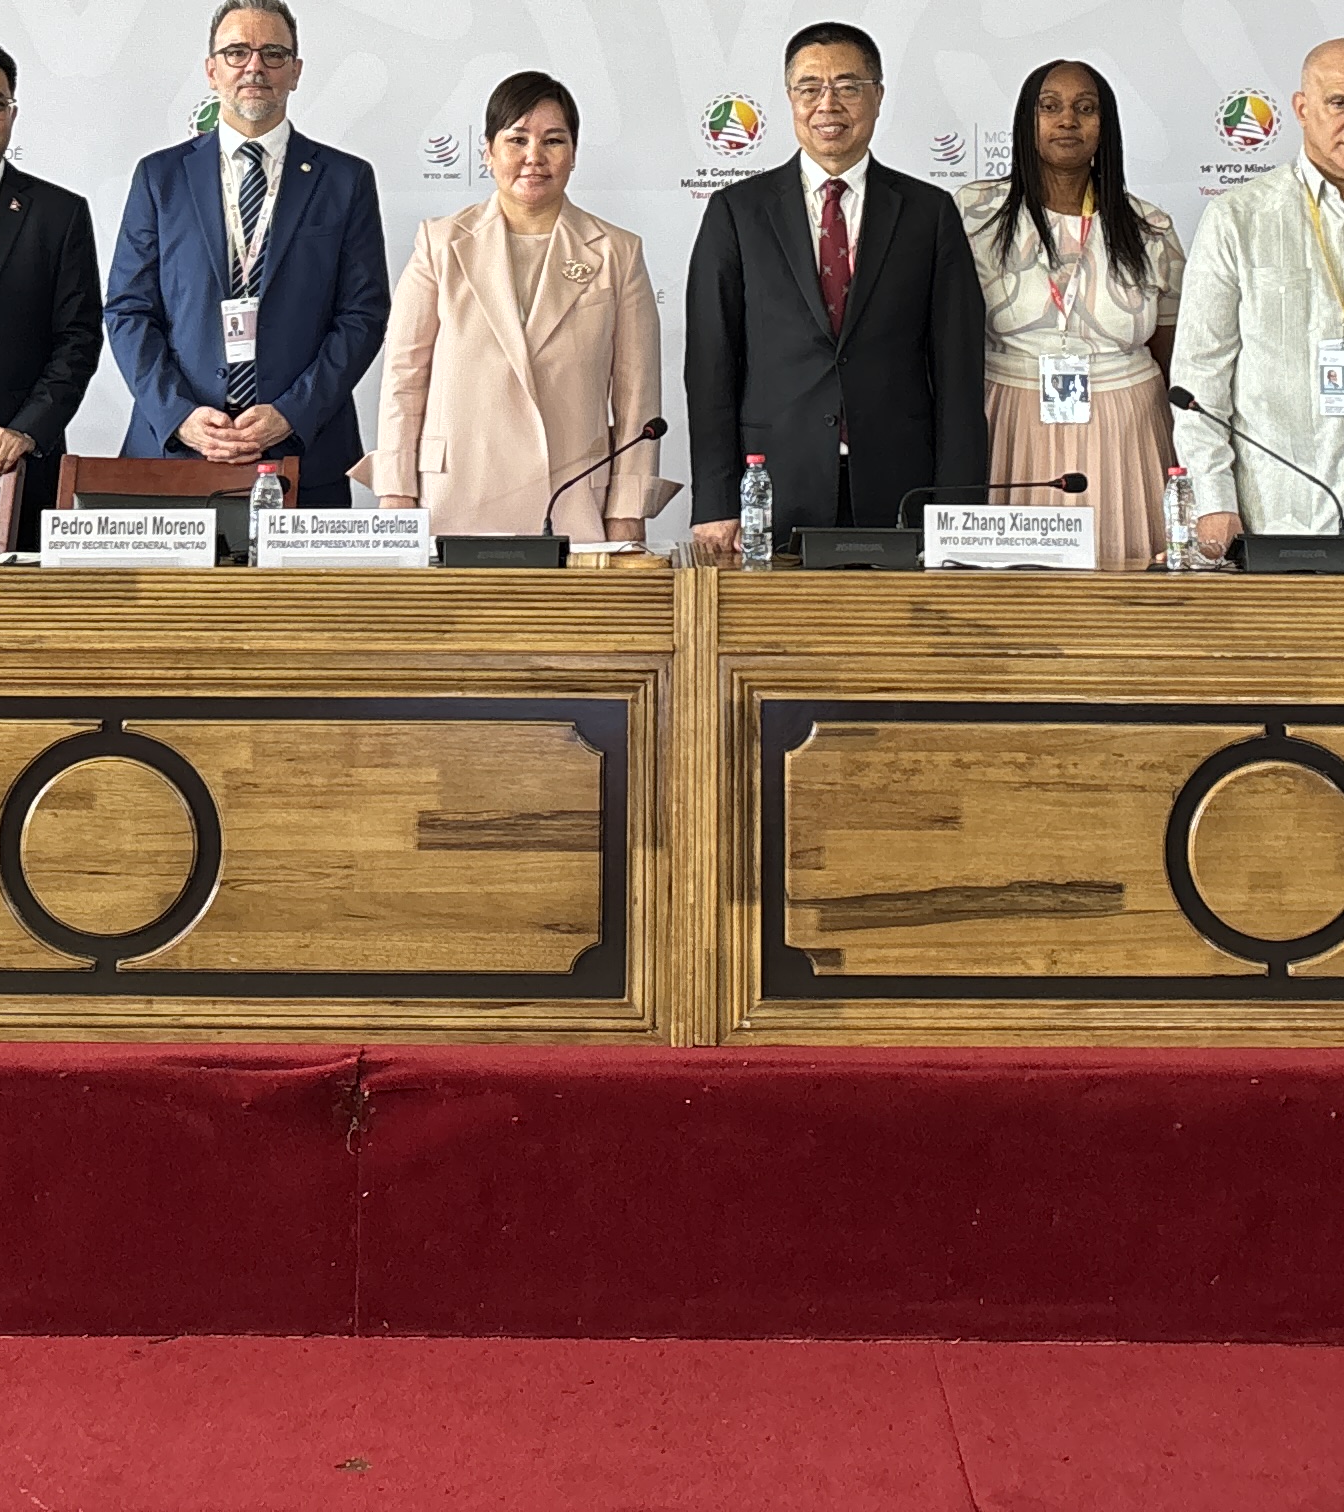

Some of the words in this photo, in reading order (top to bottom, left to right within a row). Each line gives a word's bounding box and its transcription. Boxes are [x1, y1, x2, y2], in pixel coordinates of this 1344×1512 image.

[696, 168, 708, 176] 14
[1200, 165, 1213, 173] 14
[1216, 164, 1242, 173] WTO
[51, 517, 93, 535] Pedro
[98, 517, 147, 535] Manuel
[152, 517, 205, 535] Moreno
[269, 516, 288, 534] H.E.
[292, 516, 308, 534] Ms.
[312, 516, 369, 534] Davaasuren
[372, 515, 418, 534] Gerelmaa
[937, 512, 958, 530] Mr.
[962, 512, 1005, 535] Zhang
[1010, 513, 1082, 536] Xiangchen
[49, 541, 80, 550] DEPUTY
[82, 541, 129, 550] SECRETARY
[132, 541, 172, 550] GENERAL,
[174, 541, 206, 550] UNCTAD
[267, 540, 308, 548] PERMANENT
[310, 540, 370, 548] REPRESENTATIVE
[372, 540, 381, 548] OF
[383, 540, 419, 548] MONGOLIA
[940, 537, 958, 545] WTO
[961, 537, 993, 545] DEPUTY
[996, 537, 1080, 547] DIRECTOR-GENERAL
